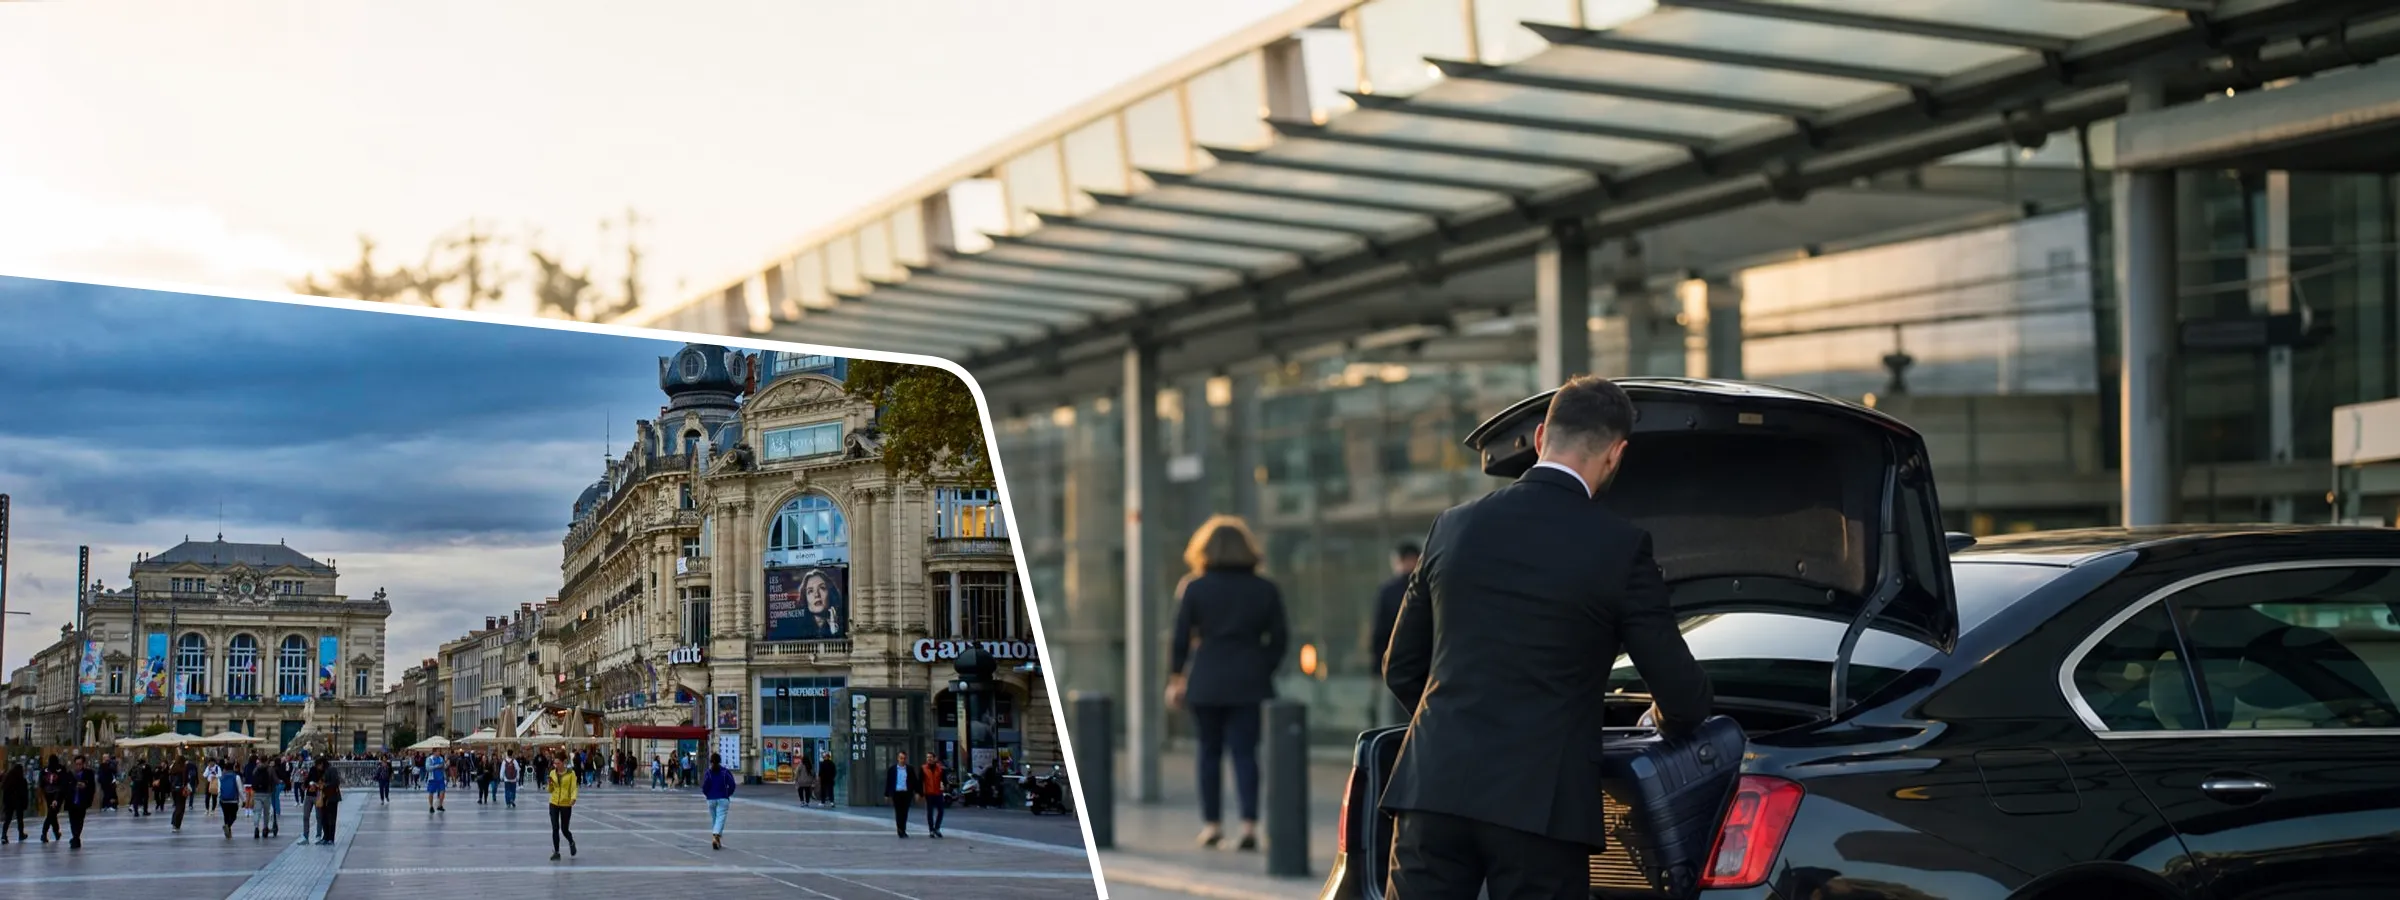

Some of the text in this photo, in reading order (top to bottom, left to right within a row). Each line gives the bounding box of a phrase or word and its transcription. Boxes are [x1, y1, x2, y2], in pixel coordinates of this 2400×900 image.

[769, 576, 779, 584] LES
[769, 584, 783, 593] PLUS
[769, 593, 788, 601] BELLES
[769, 601, 796, 610] HISTOIRES
[769, 609, 805, 619] COMMENCENT
[852, 695, 867, 760] Parking
